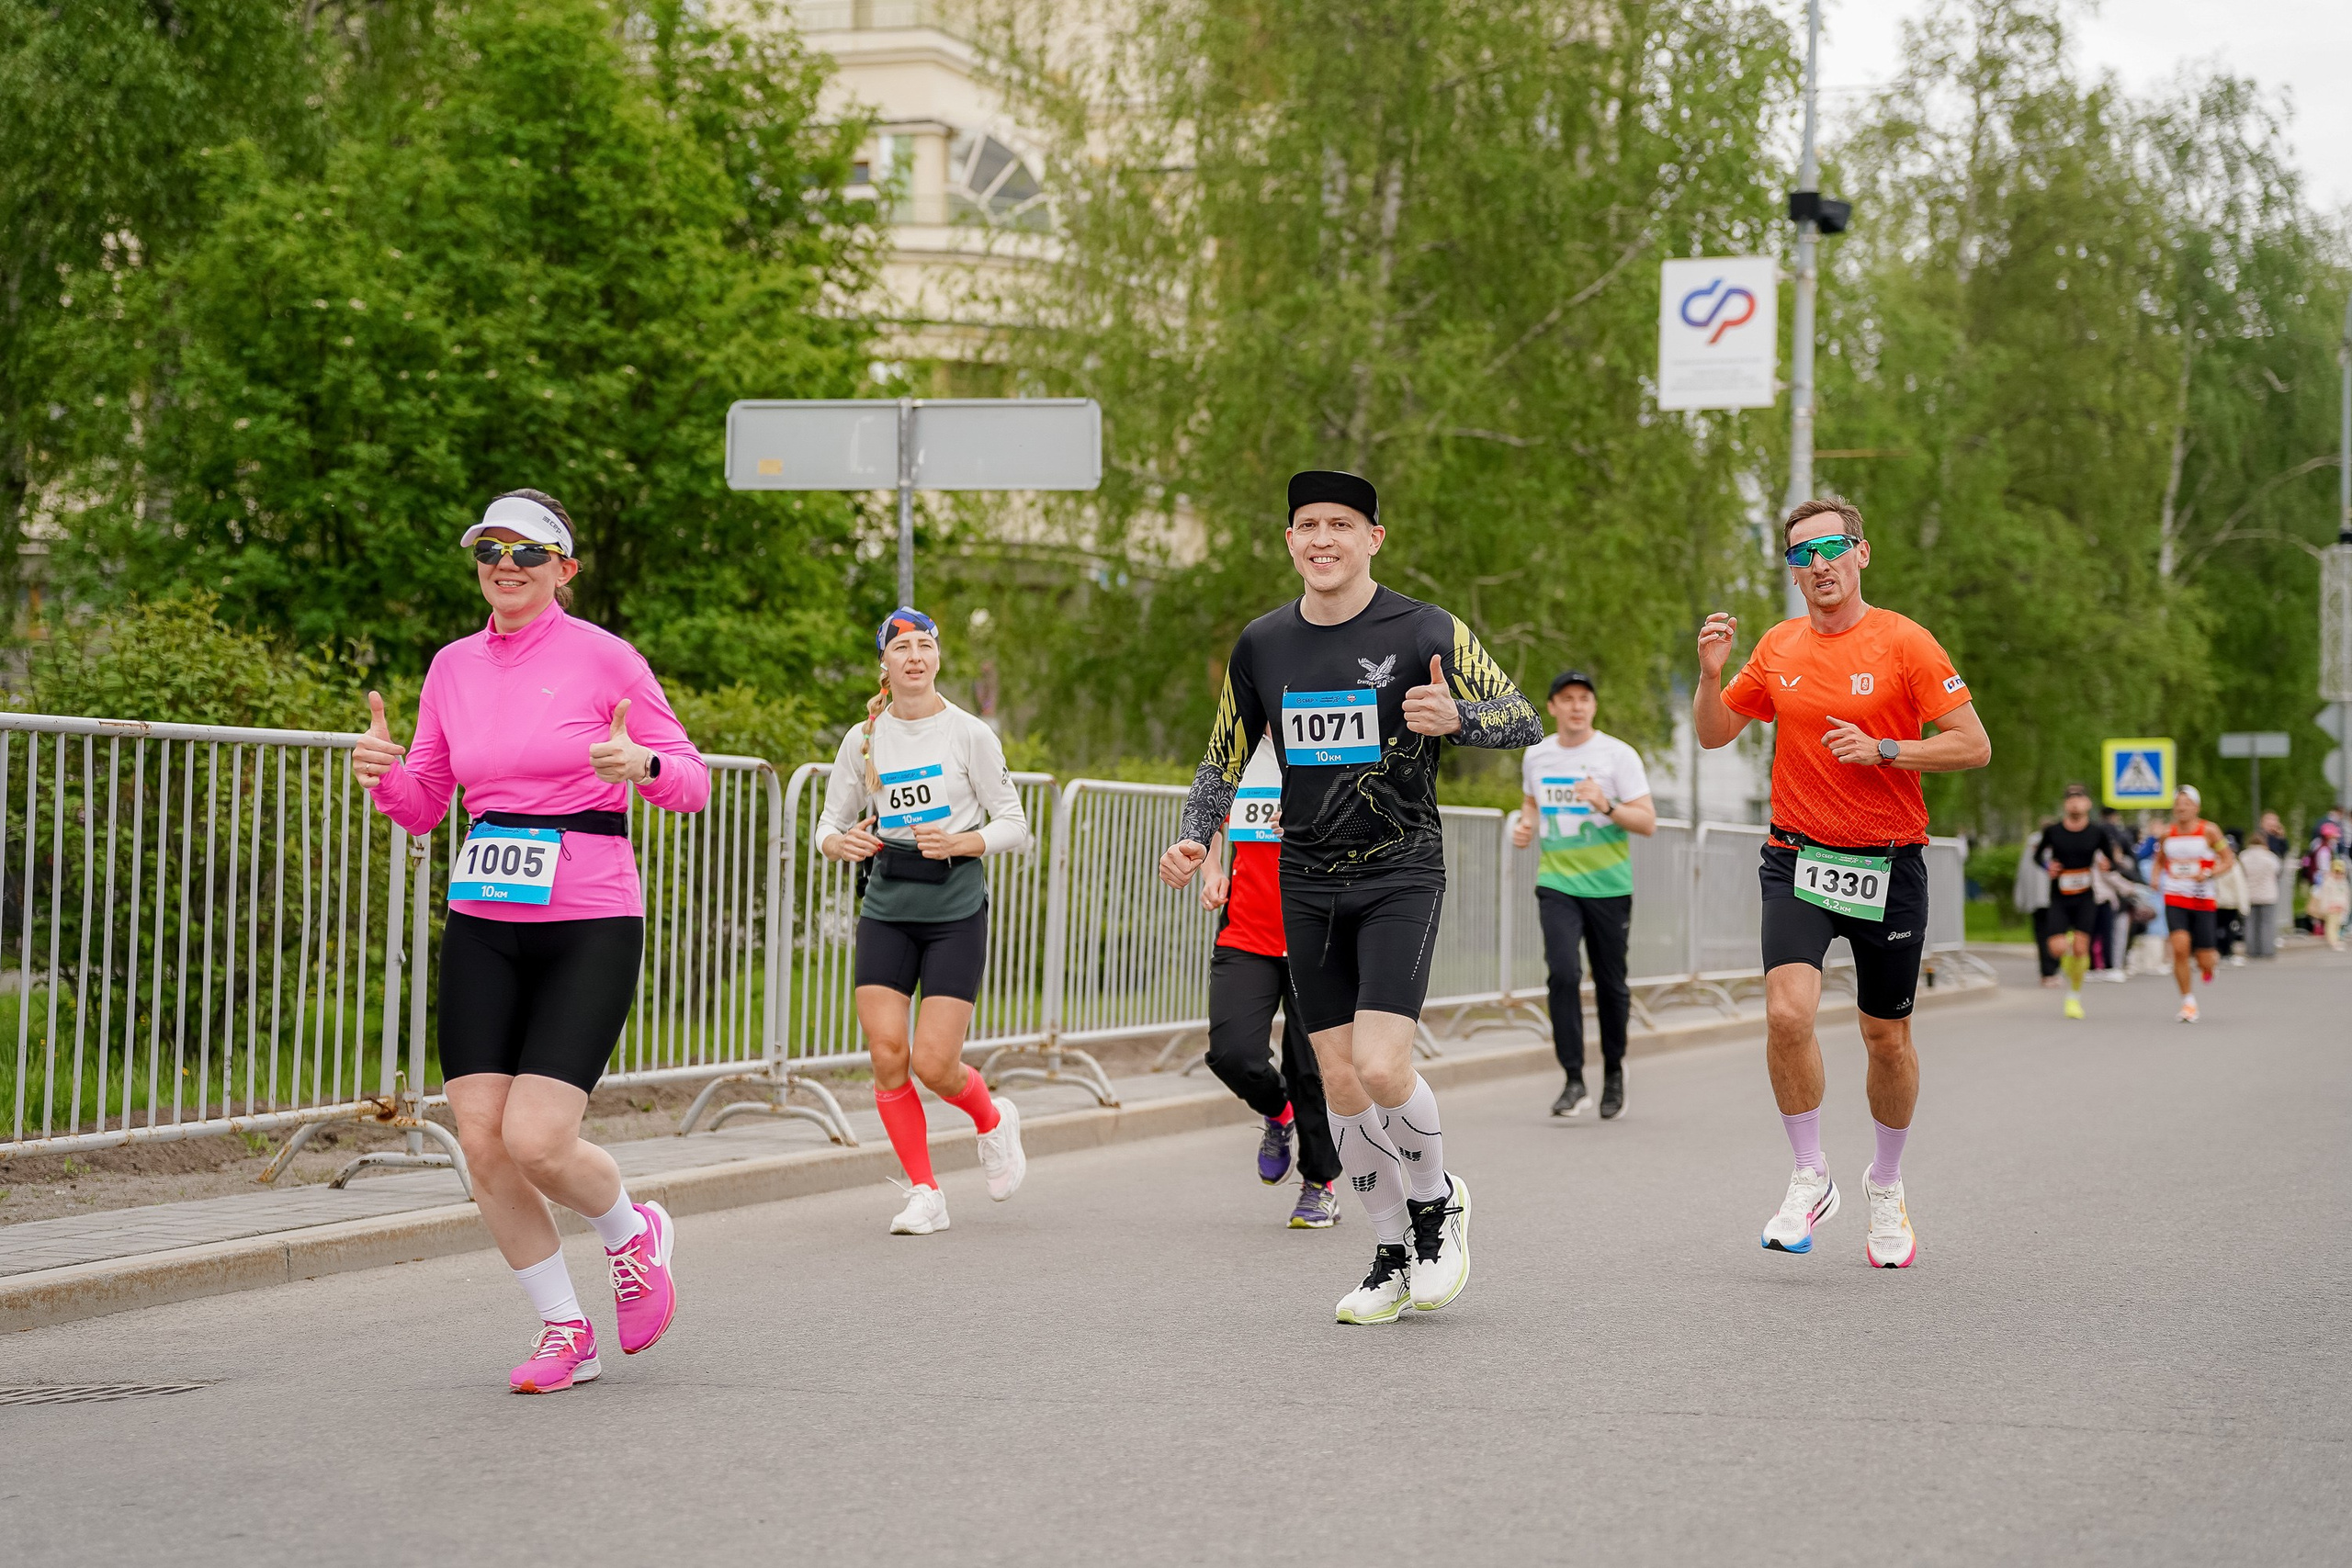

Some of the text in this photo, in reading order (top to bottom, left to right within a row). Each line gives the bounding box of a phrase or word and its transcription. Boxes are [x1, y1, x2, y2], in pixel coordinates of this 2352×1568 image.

[1849, 672, 1874, 695] 10
[1292, 711, 1365, 742] 1071
[889, 784, 932, 809] 650
[1546, 789, 1580, 803] 100
[1245, 803, 1282, 824] 89
[467, 843, 546, 878] 1005
[1805, 865, 1879, 900] 1330
